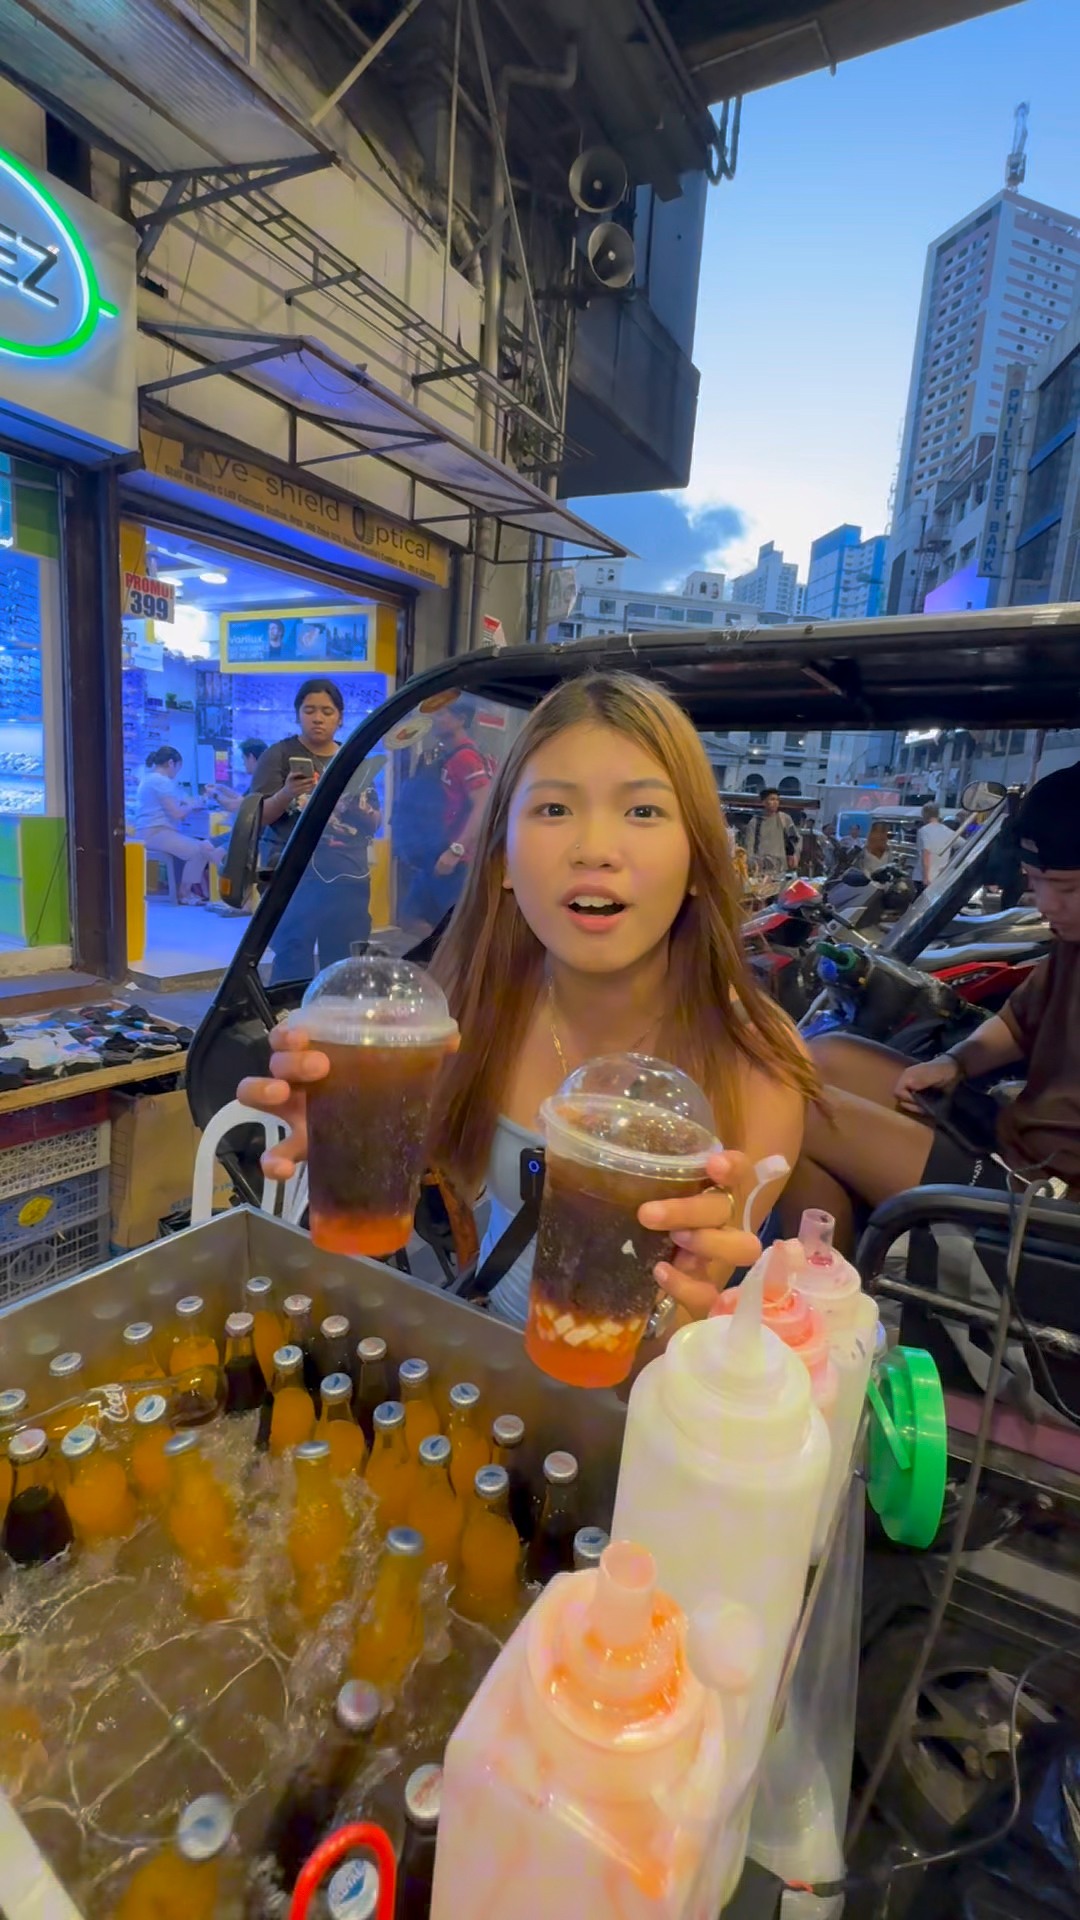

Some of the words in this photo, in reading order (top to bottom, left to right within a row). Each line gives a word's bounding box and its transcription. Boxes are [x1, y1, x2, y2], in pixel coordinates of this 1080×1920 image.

[994, 388, 1021, 510] PHILTRUST
[983, 521, 1000, 571] BANK
[130, 590, 169, 620] 399
